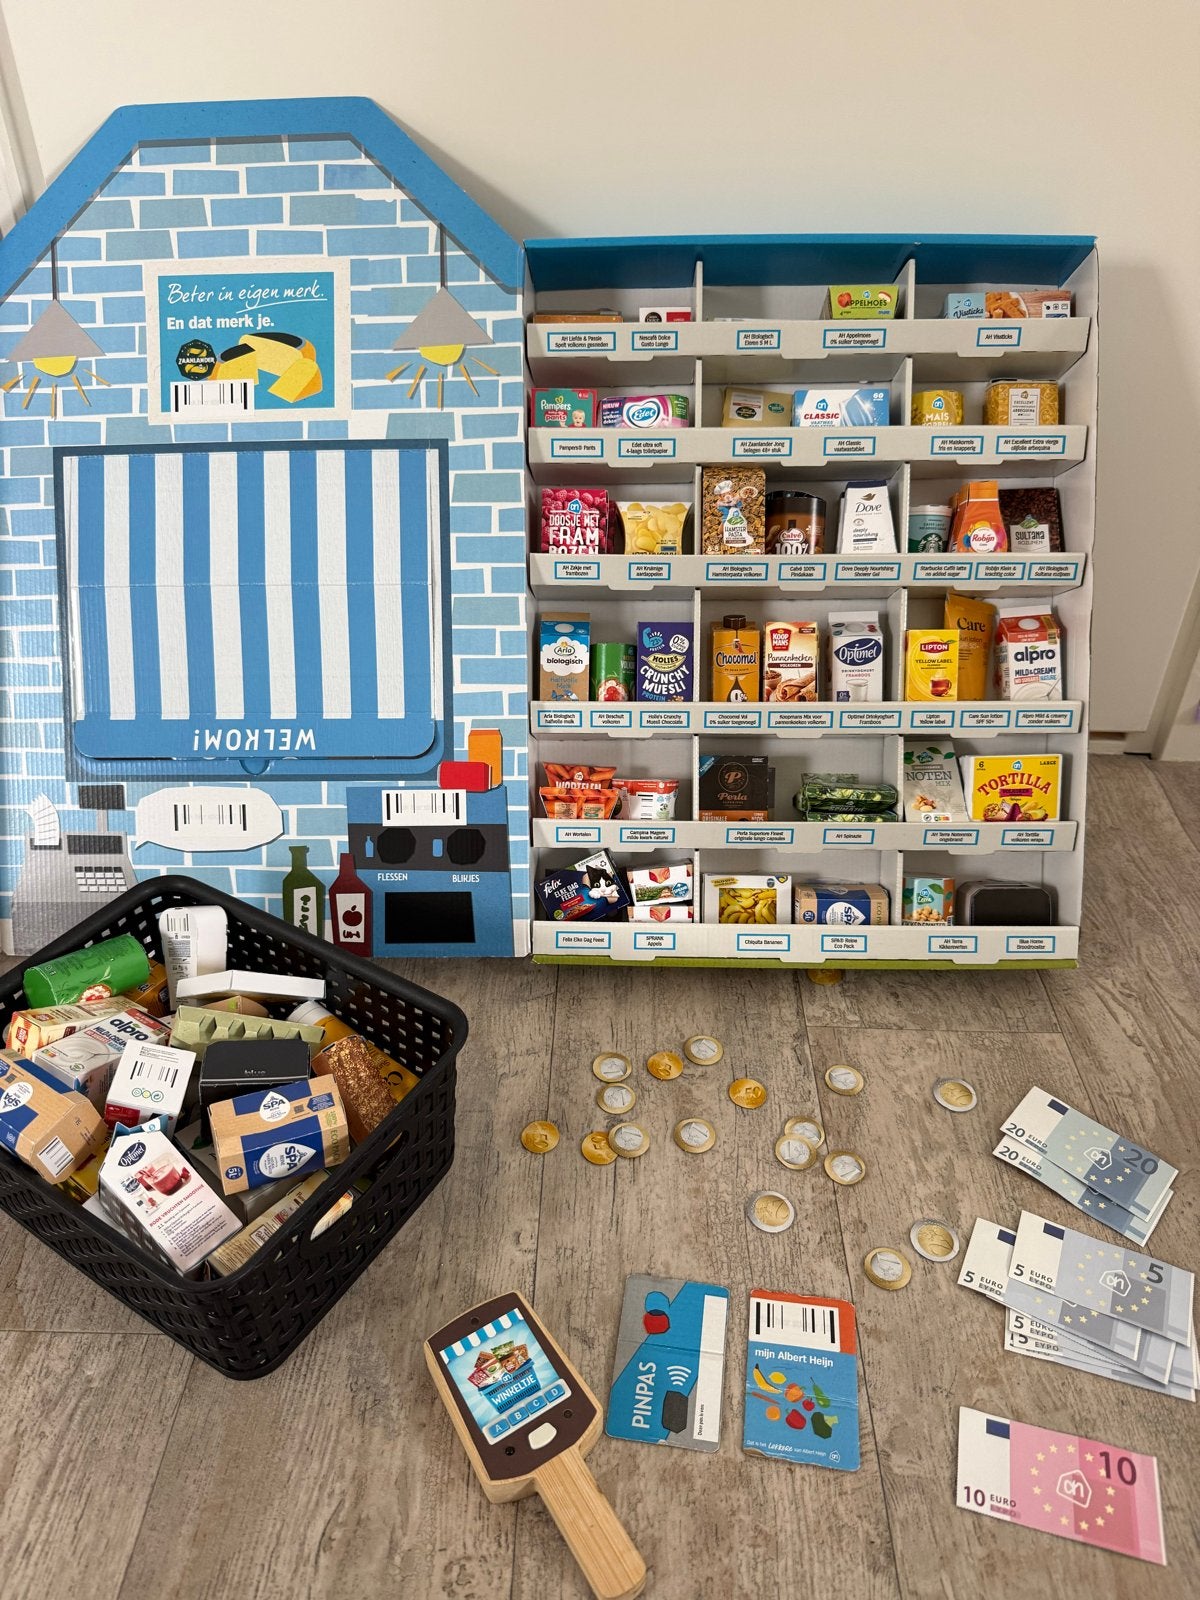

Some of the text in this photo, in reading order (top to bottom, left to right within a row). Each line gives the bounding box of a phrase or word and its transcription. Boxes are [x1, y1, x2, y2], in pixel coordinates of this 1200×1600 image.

[168, 280, 324, 309] Beter in eigen merk.
[844, 299, 888, 307] APPELMOES
[953, 308, 984, 318] Vissticks
[167, 314, 274, 330] En dat merk je.
[178, 356, 215, 365] ZAANLANDER
[541, 400, 571, 410] Pampers
[633, 408, 654, 419] Edet
[925, 413, 949, 421] MAIS
[855, 502, 881, 512] Dove
[550, 515, 599, 526] DOOSJE MET
[550, 527, 599, 544] FRAM
[972, 534, 995, 543] Robijn
[1015, 531, 1044, 540] SULTANA
[775, 543, 808, 554] 100%
[957, 617, 985, 632] Care
[673, 635, 686, 644] 0%
[557, 646, 572, 654] Arla
[768, 653, 813, 662] Pannenkoeken
[839, 640, 877, 663] Optimel
[1014, 646, 1055, 664] alpro
[547, 657, 583, 665] biologisch
[652, 655, 679, 664] HOLIE'S
[716, 652, 757, 667] Chocomel
[640, 665, 689, 683] CRUNCHY
[642, 679, 686, 694] MUESLI
[642, 691, 666, 701] PROTEIN
[730, 689, 747, 702] 0%
[193, 728, 317, 751] WELKOM!
[907, 771, 952, 781] NOTEN
[977, 773, 1052, 795] TORTILLA
[717, 792, 747, 800] Perla
[377, 872, 408, 881] FLESSEN
[452, 874, 480, 883] BLIKJES
[544, 878, 562, 898] felix
[554, 882, 579, 898] ELKE DAG
[561, 891, 577, 901] FEEST
[110, 1019, 148, 1040] alpro
[263, 1098, 286, 1110] SPA
[1005, 1123, 1047, 1148] 20 EURO
[120, 1144, 145, 1166] Optimel
[285, 1146, 298, 1171] SPA
[999, 1146, 1041, 1170] 20 EURO
[1123, 1148, 1158, 1175] 20
[150, 1184, 205, 1227] RODE VRUCHTEN SMOOTHIE
[964, 1271, 1003, 1289] 5 EURO
[1014, 1264, 1053, 1283] 5 EURO
[1147, 1265, 1163, 1283] 5
[1014, 1316, 1024, 1329] 5
[755, 1348, 833, 1368] mijn Albert Heijn
[492, 1374, 536, 1405] WINKELTJE
[632, 1362, 656, 1428] PINPAS
[495, 1387, 558, 1433] A B C D
[1100, 1452, 1136, 1486] 10
[964, 1486, 1016, 1508] 10 EURO
